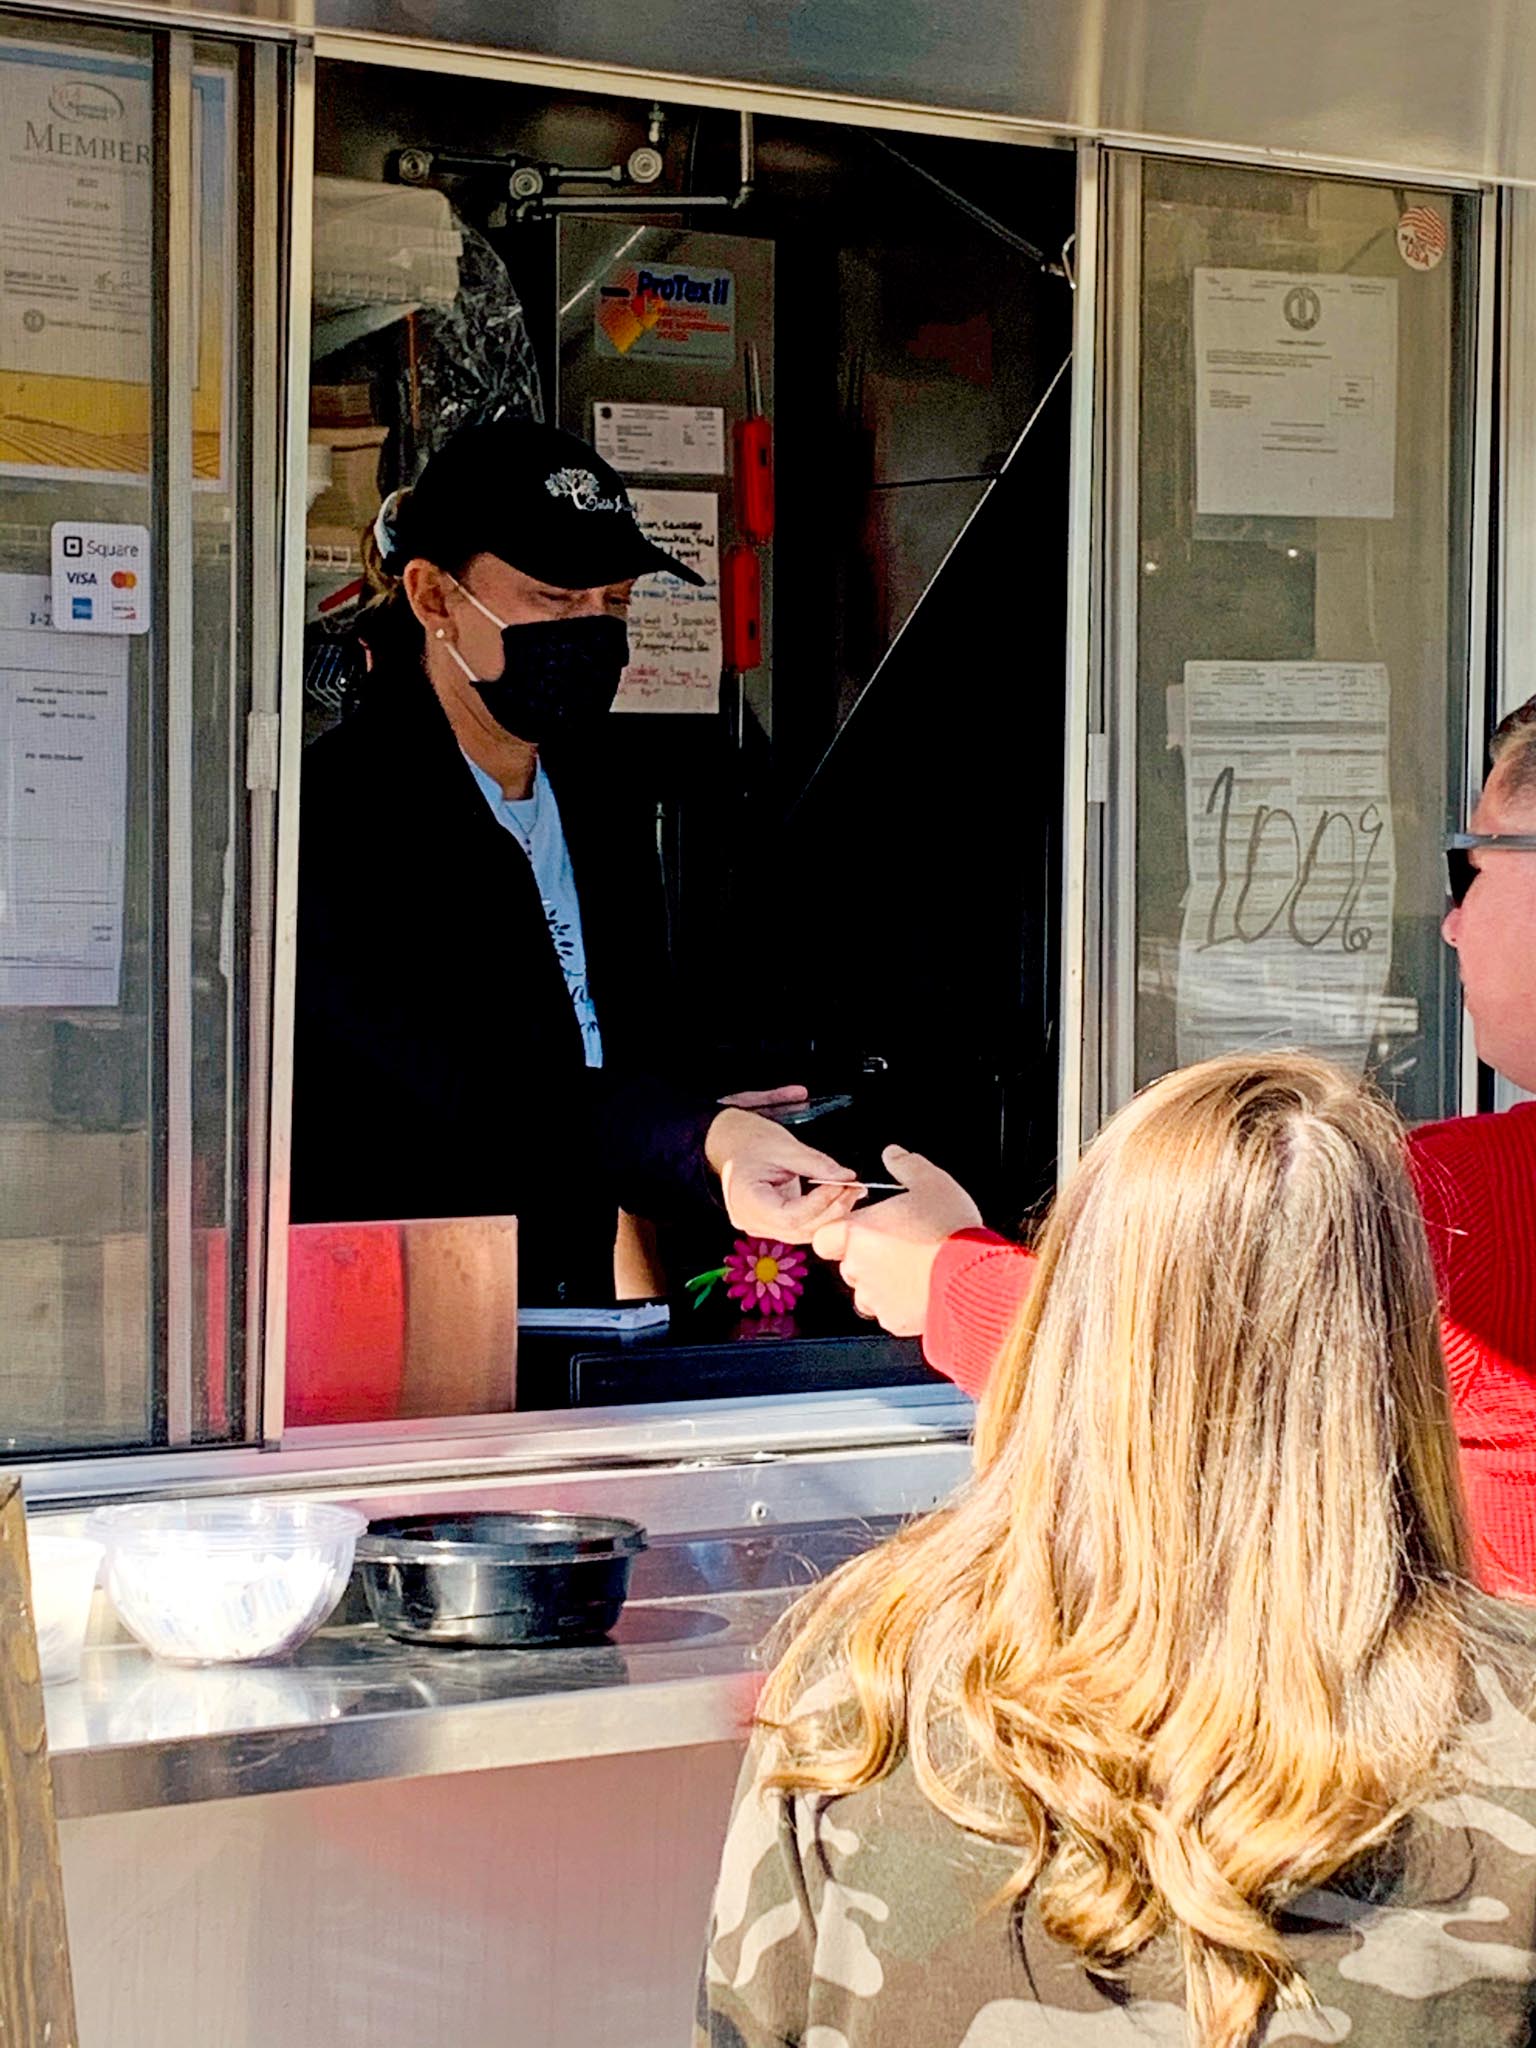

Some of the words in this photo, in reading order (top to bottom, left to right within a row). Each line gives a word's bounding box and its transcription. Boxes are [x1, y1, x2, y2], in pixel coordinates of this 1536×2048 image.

[25, 120, 150, 165] MEMBER
[1406, 243, 1430, 267] USA
[637, 270, 712, 304] ProTex
[87, 540, 139, 558] Square
[66, 571, 98, 585] VISA
[1196, 766, 1384, 953] 100%
